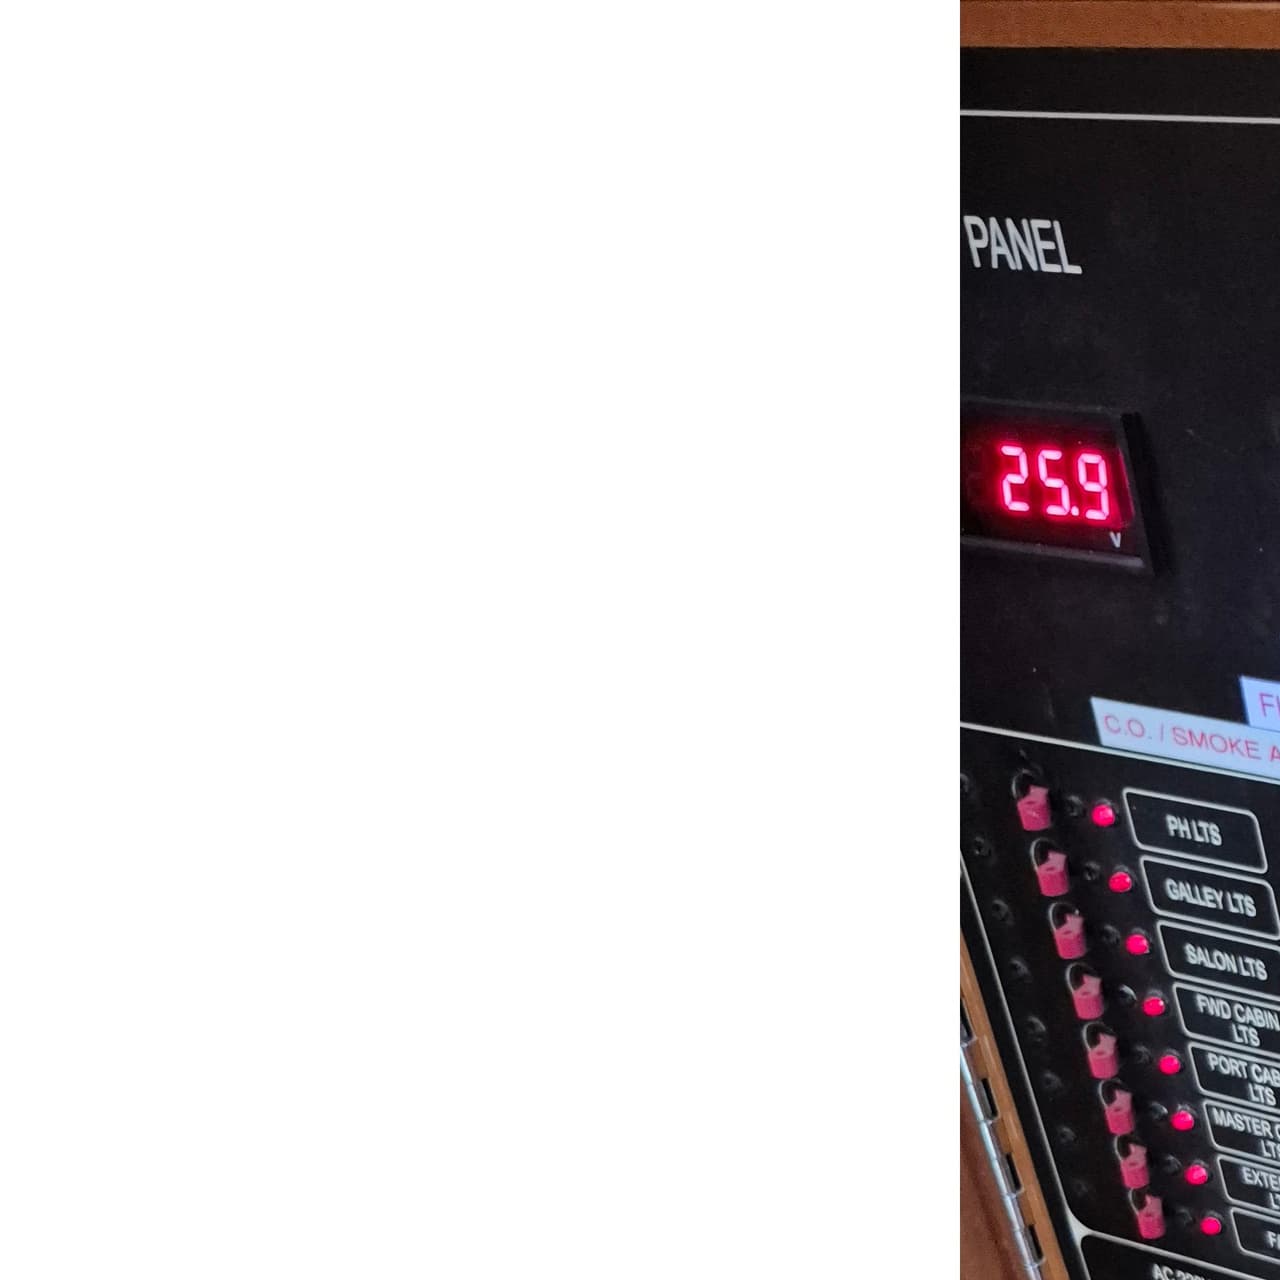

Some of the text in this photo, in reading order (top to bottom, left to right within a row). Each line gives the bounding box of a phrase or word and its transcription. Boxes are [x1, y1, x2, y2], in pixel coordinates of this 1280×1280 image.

[963, 215, 1082, 275] PANEL
[1001, 446, 1109, 520] 25.9
[1103, 713, 1151, 742] C.O.
[1159, 718, 1167, 742] /
[1171, 725, 1259, 761] SMOKE
[1166, 815, 1222, 847] PH LTS
[1165, 878, 1257, 917] GALLEY LTS
[1184, 943, 1267, 981] SALON LTS
[1195, 995, 1280, 1031] FWD CABIN
[1232, 1021, 1261, 1048] LTS
[1207, 1054, 1249, 1080] PORT
[1247, 1081, 1277, 1107] LTS
[1212, 1107, 1274, 1140] MASTER
